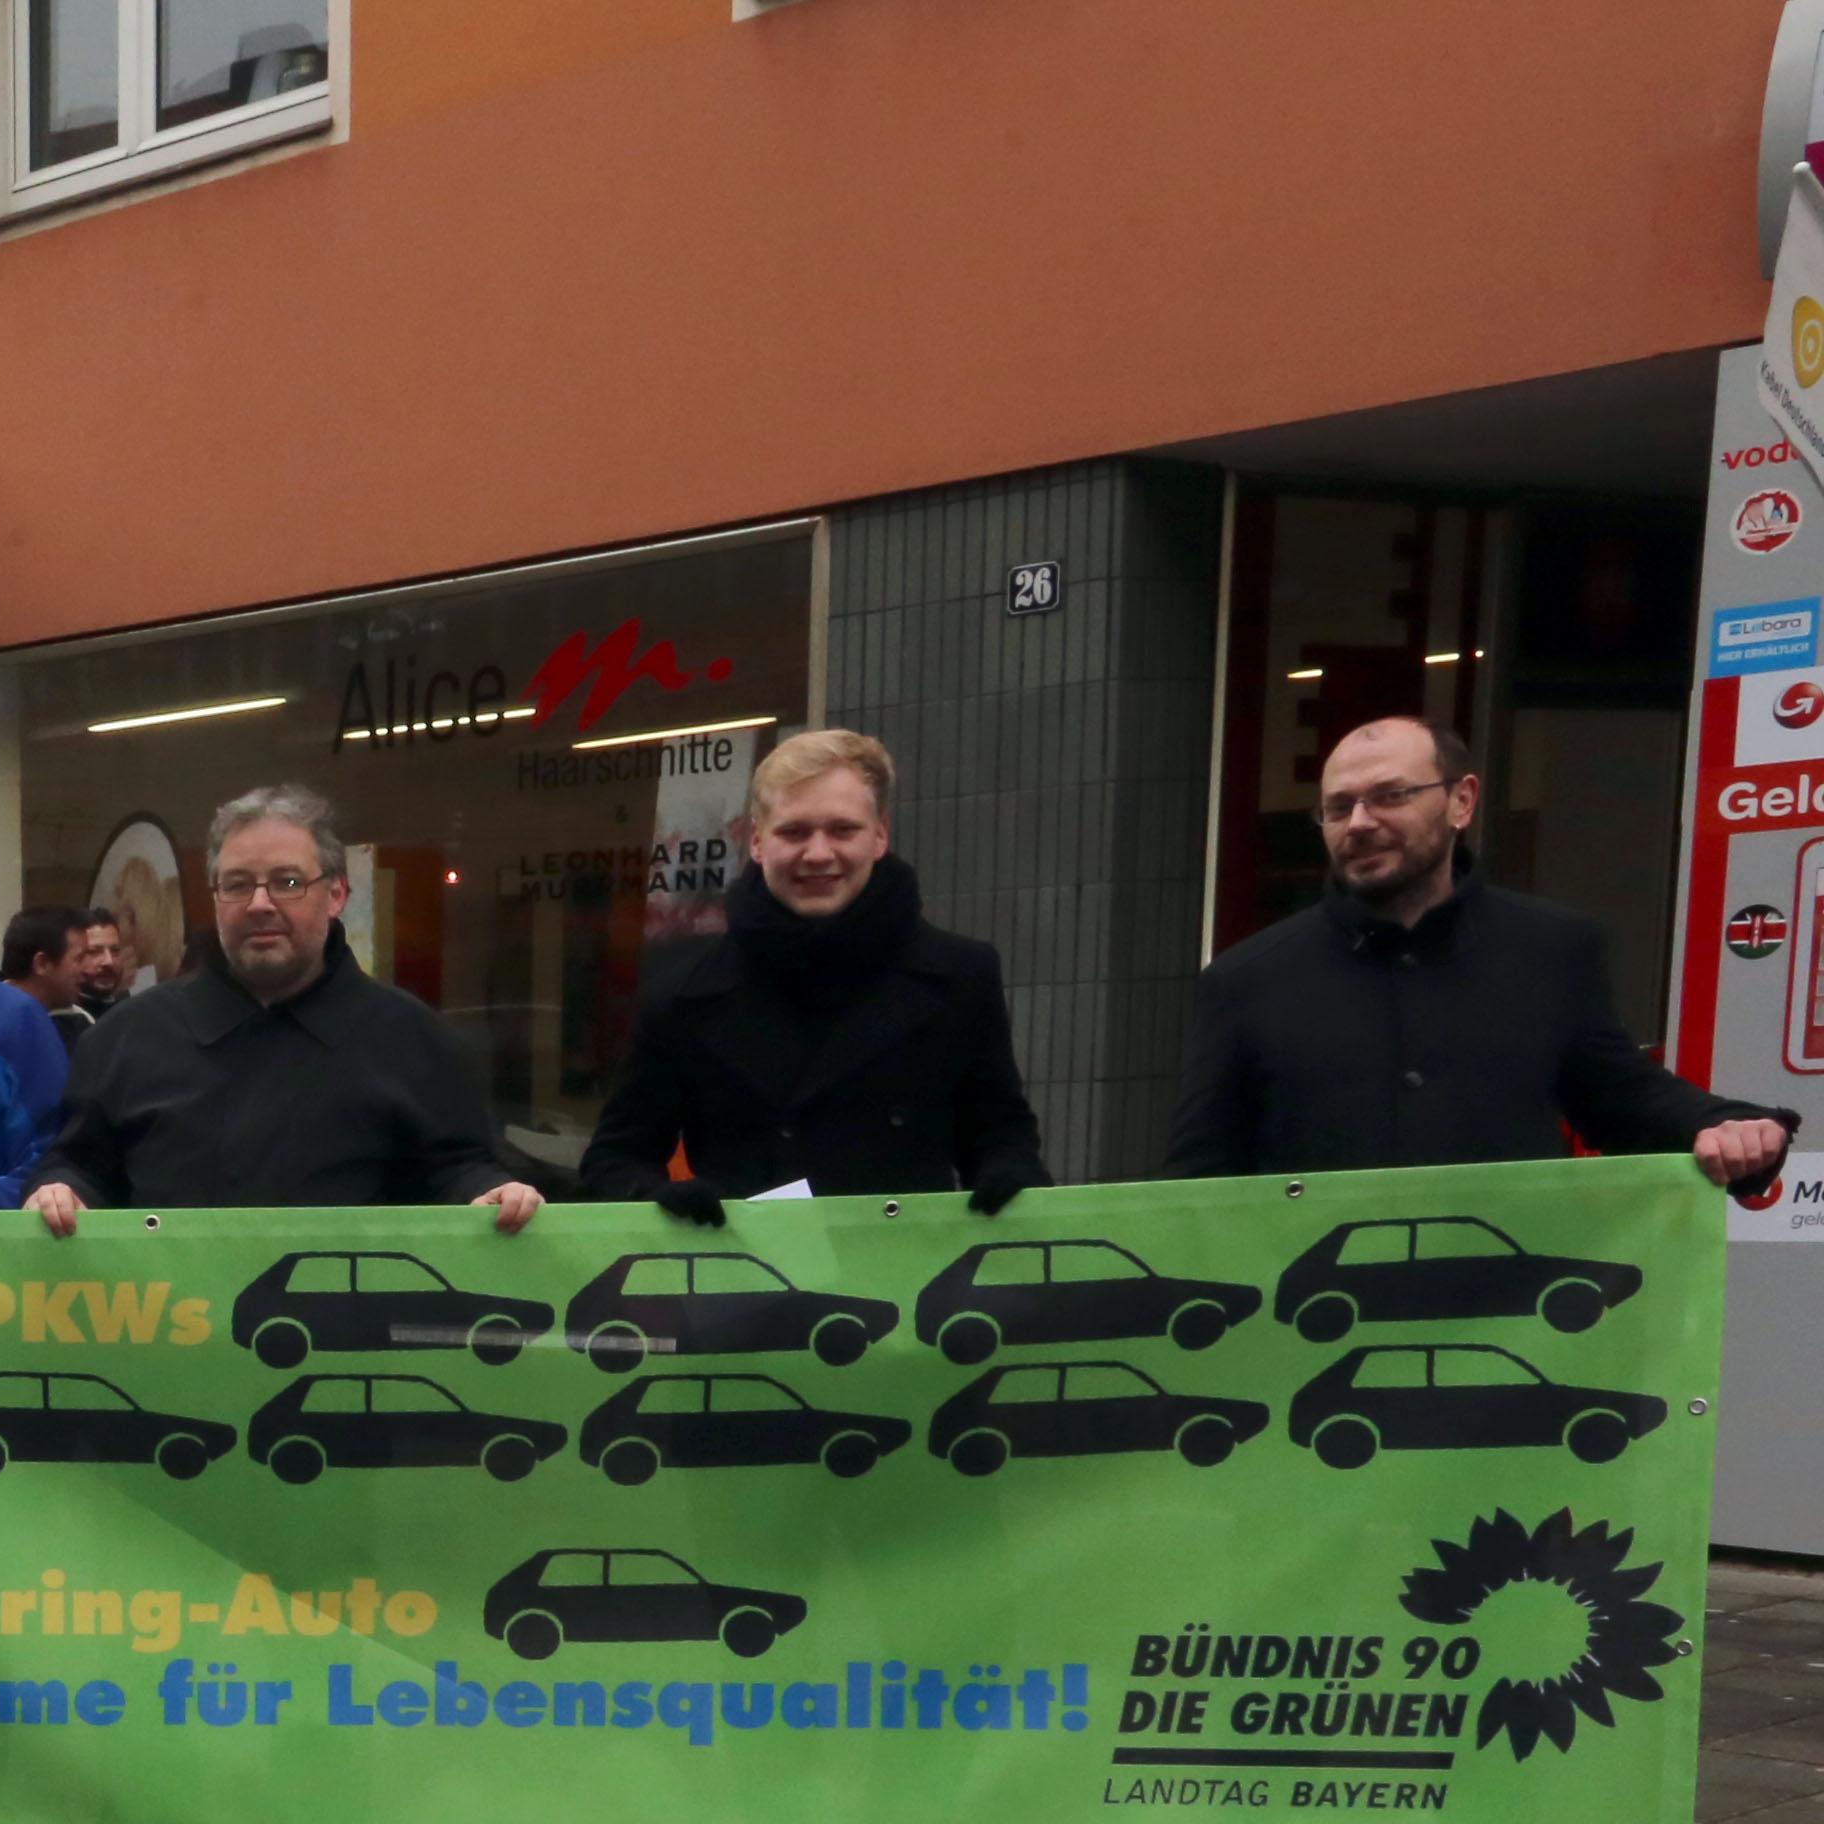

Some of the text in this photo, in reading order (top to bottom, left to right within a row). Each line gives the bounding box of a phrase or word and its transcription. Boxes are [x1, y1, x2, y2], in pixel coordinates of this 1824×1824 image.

[1014, 567, 1052, 609] 26
[332, 652, 508, 758] Alice
[518, 735, 734, 792] Haarschnitte
[519, 838, 728, 876] LEONHARD
[1130, 1621, 1482, 1682] BÜNDNIS 90
[157, 1660, 301, 1728] für
[326, 1659, 1090, 1747] Lebensqualität!
[1117, 1677, 1470, 1739] DIE GRÜNEN
[1102, 1776, 1449, 1812] LANDTAG BAYERN
